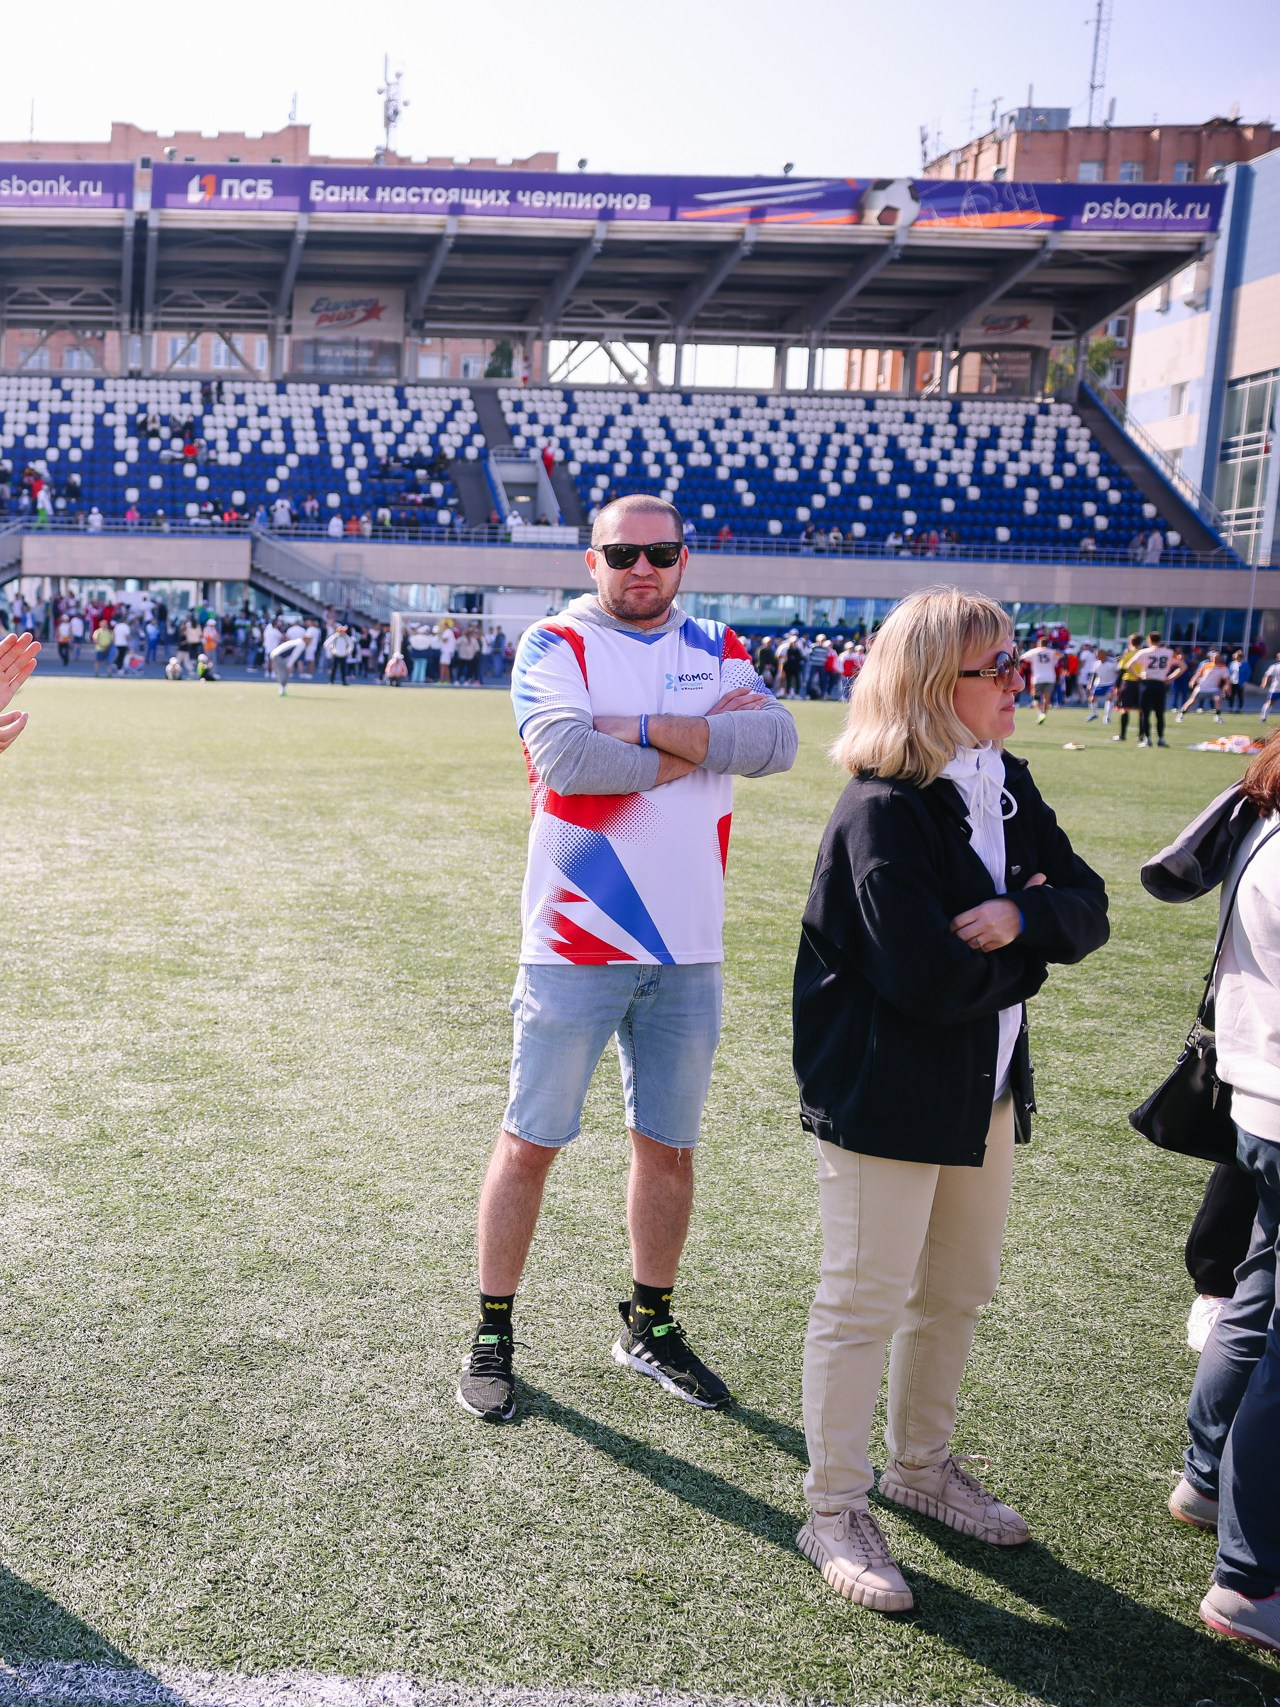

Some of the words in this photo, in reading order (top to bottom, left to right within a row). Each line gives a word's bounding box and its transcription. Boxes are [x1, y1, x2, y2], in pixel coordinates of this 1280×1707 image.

[221, 178, 274, 200] ПСБ
[309, 179, 370, 202] Банк
[376, 184, 511, 208] настоящих
[516, 190, 652, 210] чемпионов
[1081, 197, 1211, 224] psbank.ru
[1148, 656, 1168, 669] 28
[678, 673, 714, 683] КОМОС
